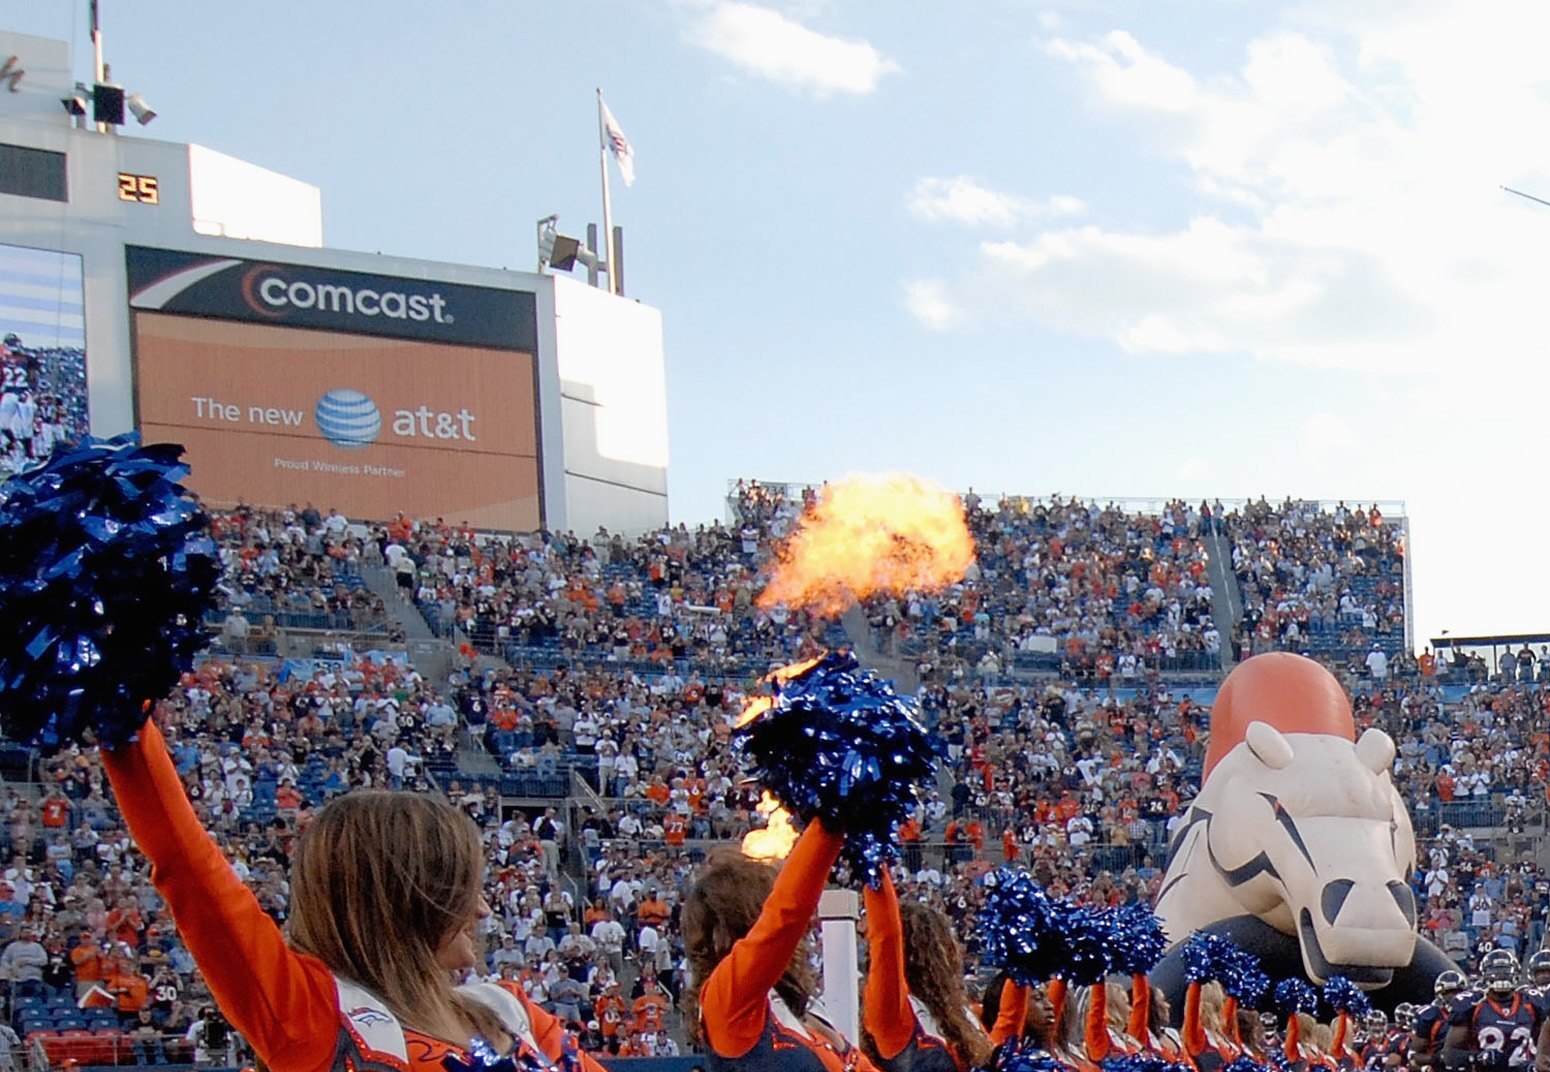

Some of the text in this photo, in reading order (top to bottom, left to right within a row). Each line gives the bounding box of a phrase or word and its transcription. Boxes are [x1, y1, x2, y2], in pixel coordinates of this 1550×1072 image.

[118, 175, 158, 205] 25
[191, 396, 477, 441] The new at&t
[274, 457, 309, 471] Proud
[363, 465, 406, 478] Partner
[691, 785, 700, 796] 6
[1150, 801, 1164, 812] 24
[671, 821, 684, 833] 77
[156, 986, 177, 1001] 30
